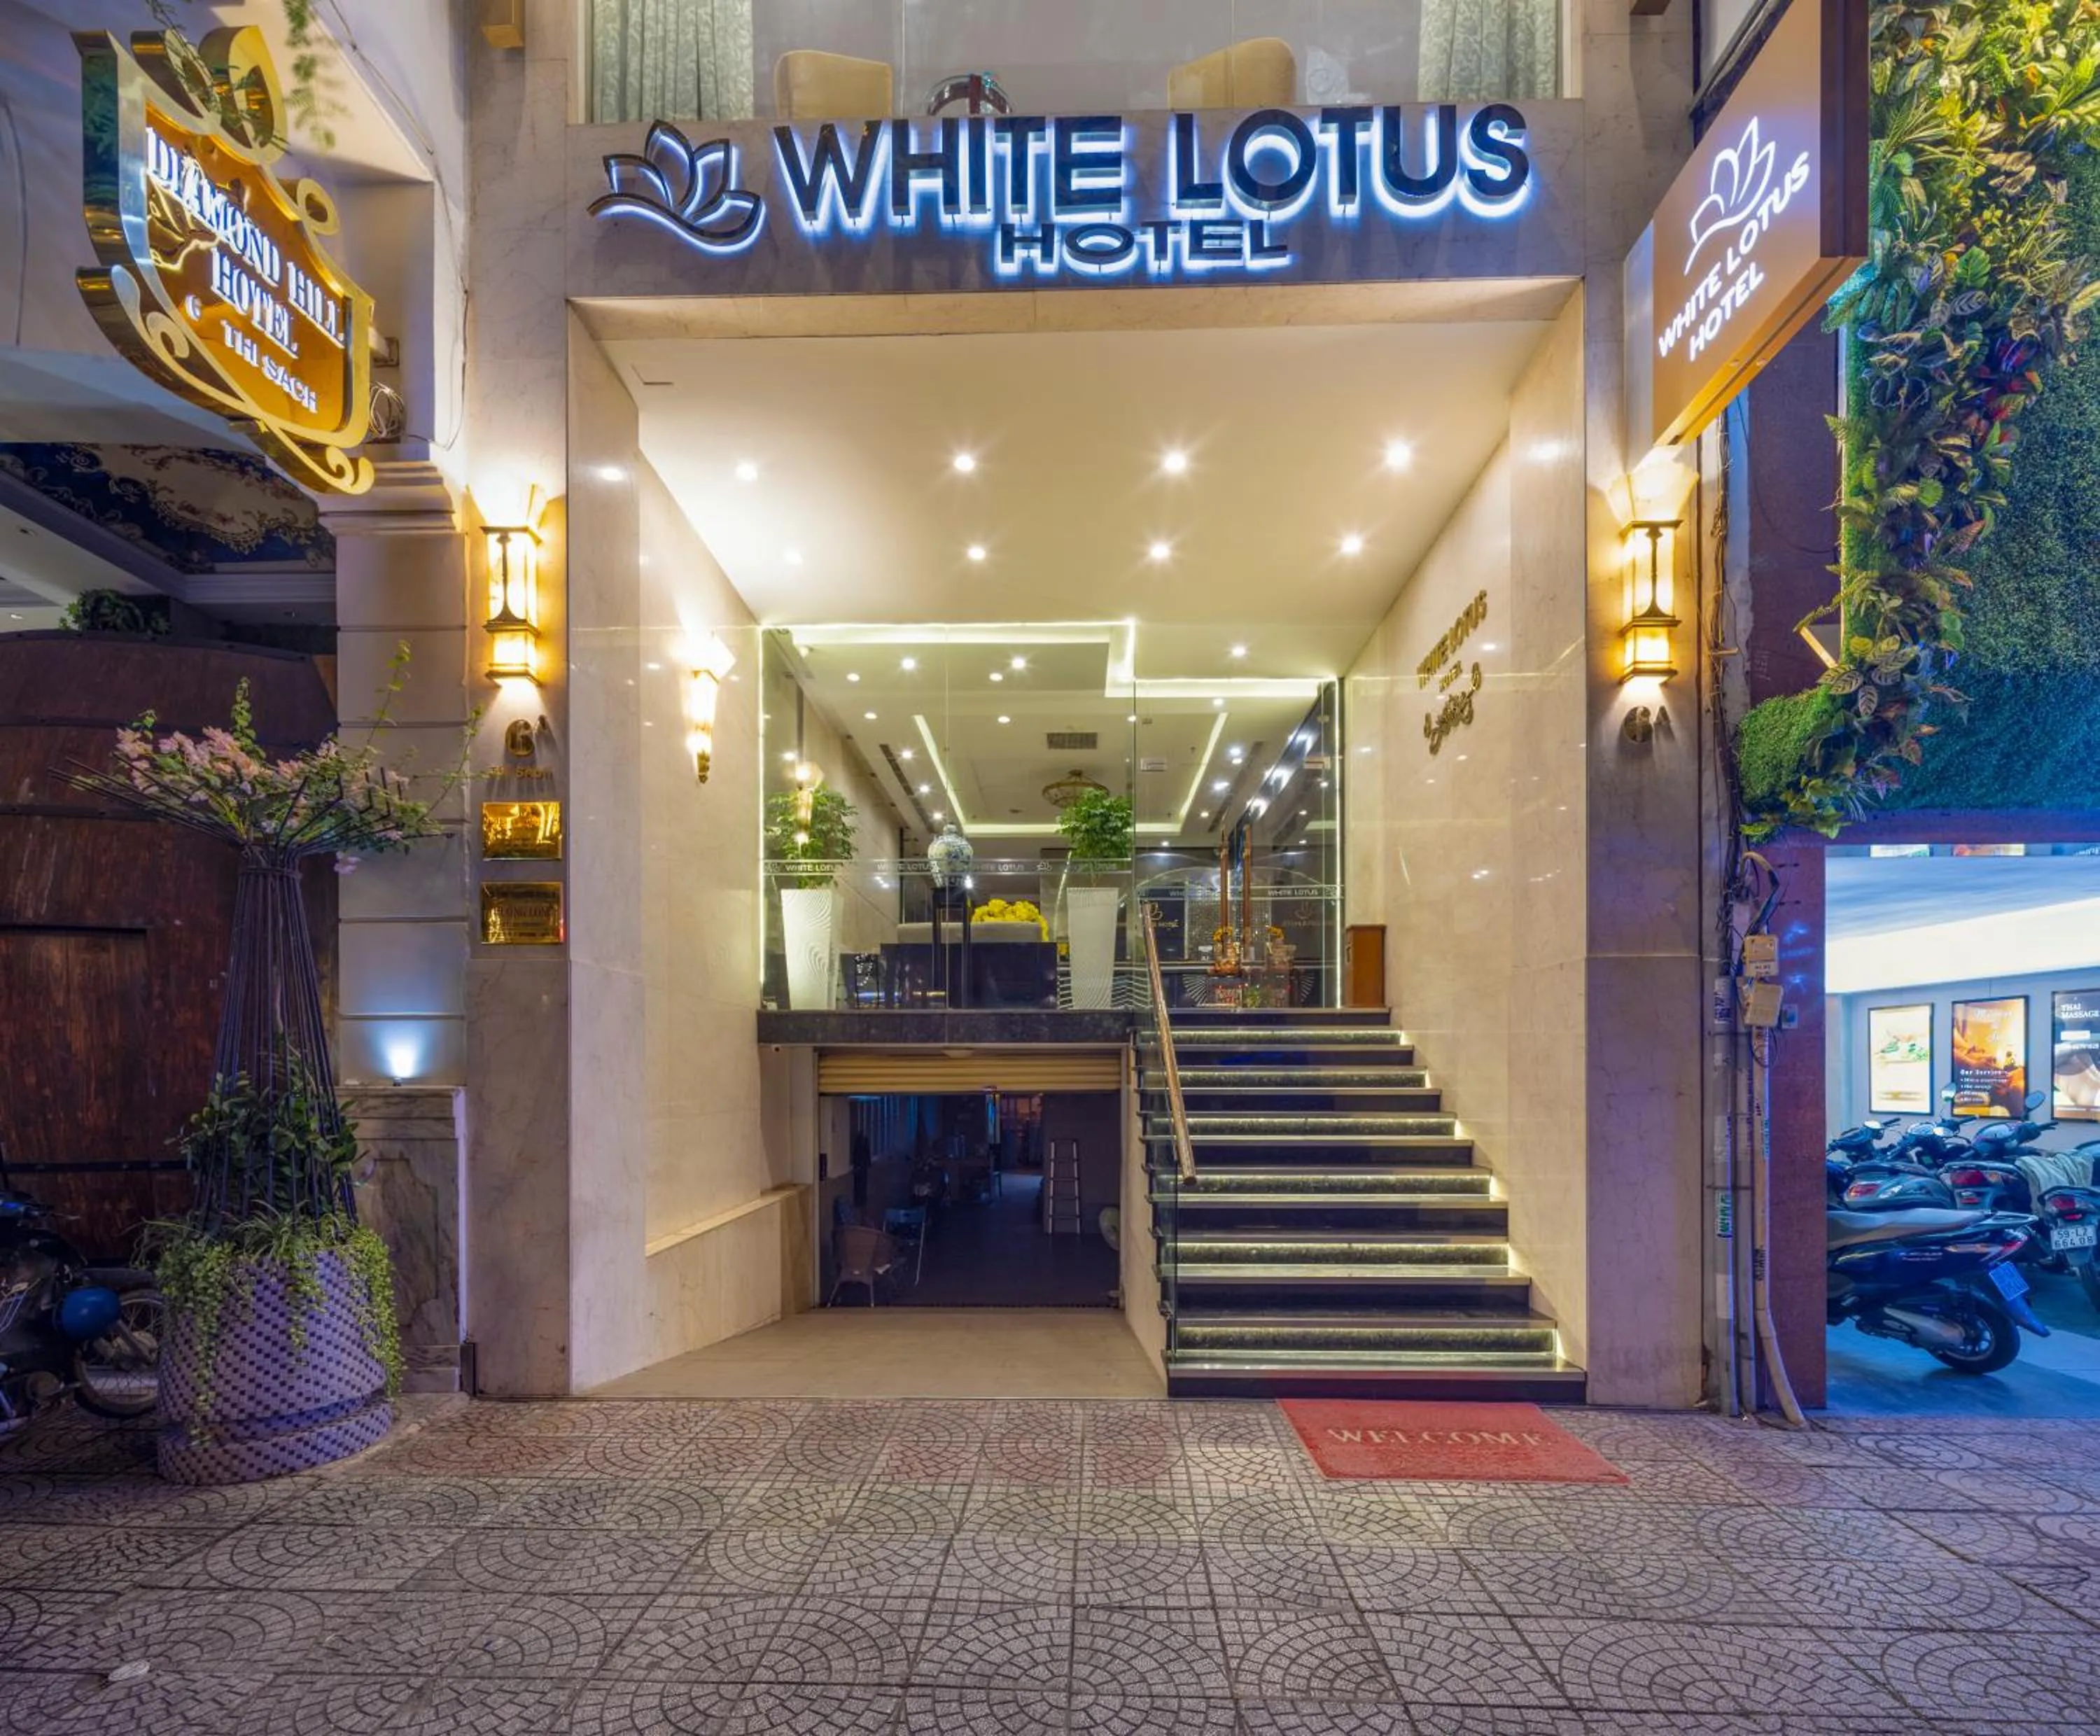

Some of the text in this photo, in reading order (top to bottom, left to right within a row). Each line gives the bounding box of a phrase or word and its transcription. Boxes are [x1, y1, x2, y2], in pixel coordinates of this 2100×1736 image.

[774, 104, 1530, 225] WHITE LOTUS
[146, 126, 346, 349] DIAMOND HILL
[1000, 218, 1289, 266] HOTEL
[1658, 151, 1810, 358] WHITE LOTUS
[211, 245, 299, 359] HOTEL
[1689, 262, 1765, 362] HOTEL
[220, 318, 260, 367] THI
[261, 354, 318, 414] SACH
[2061, 1010, 2099, 1019] MASSAGE
[1327, 1428, 1548, 1446] WELCOME
